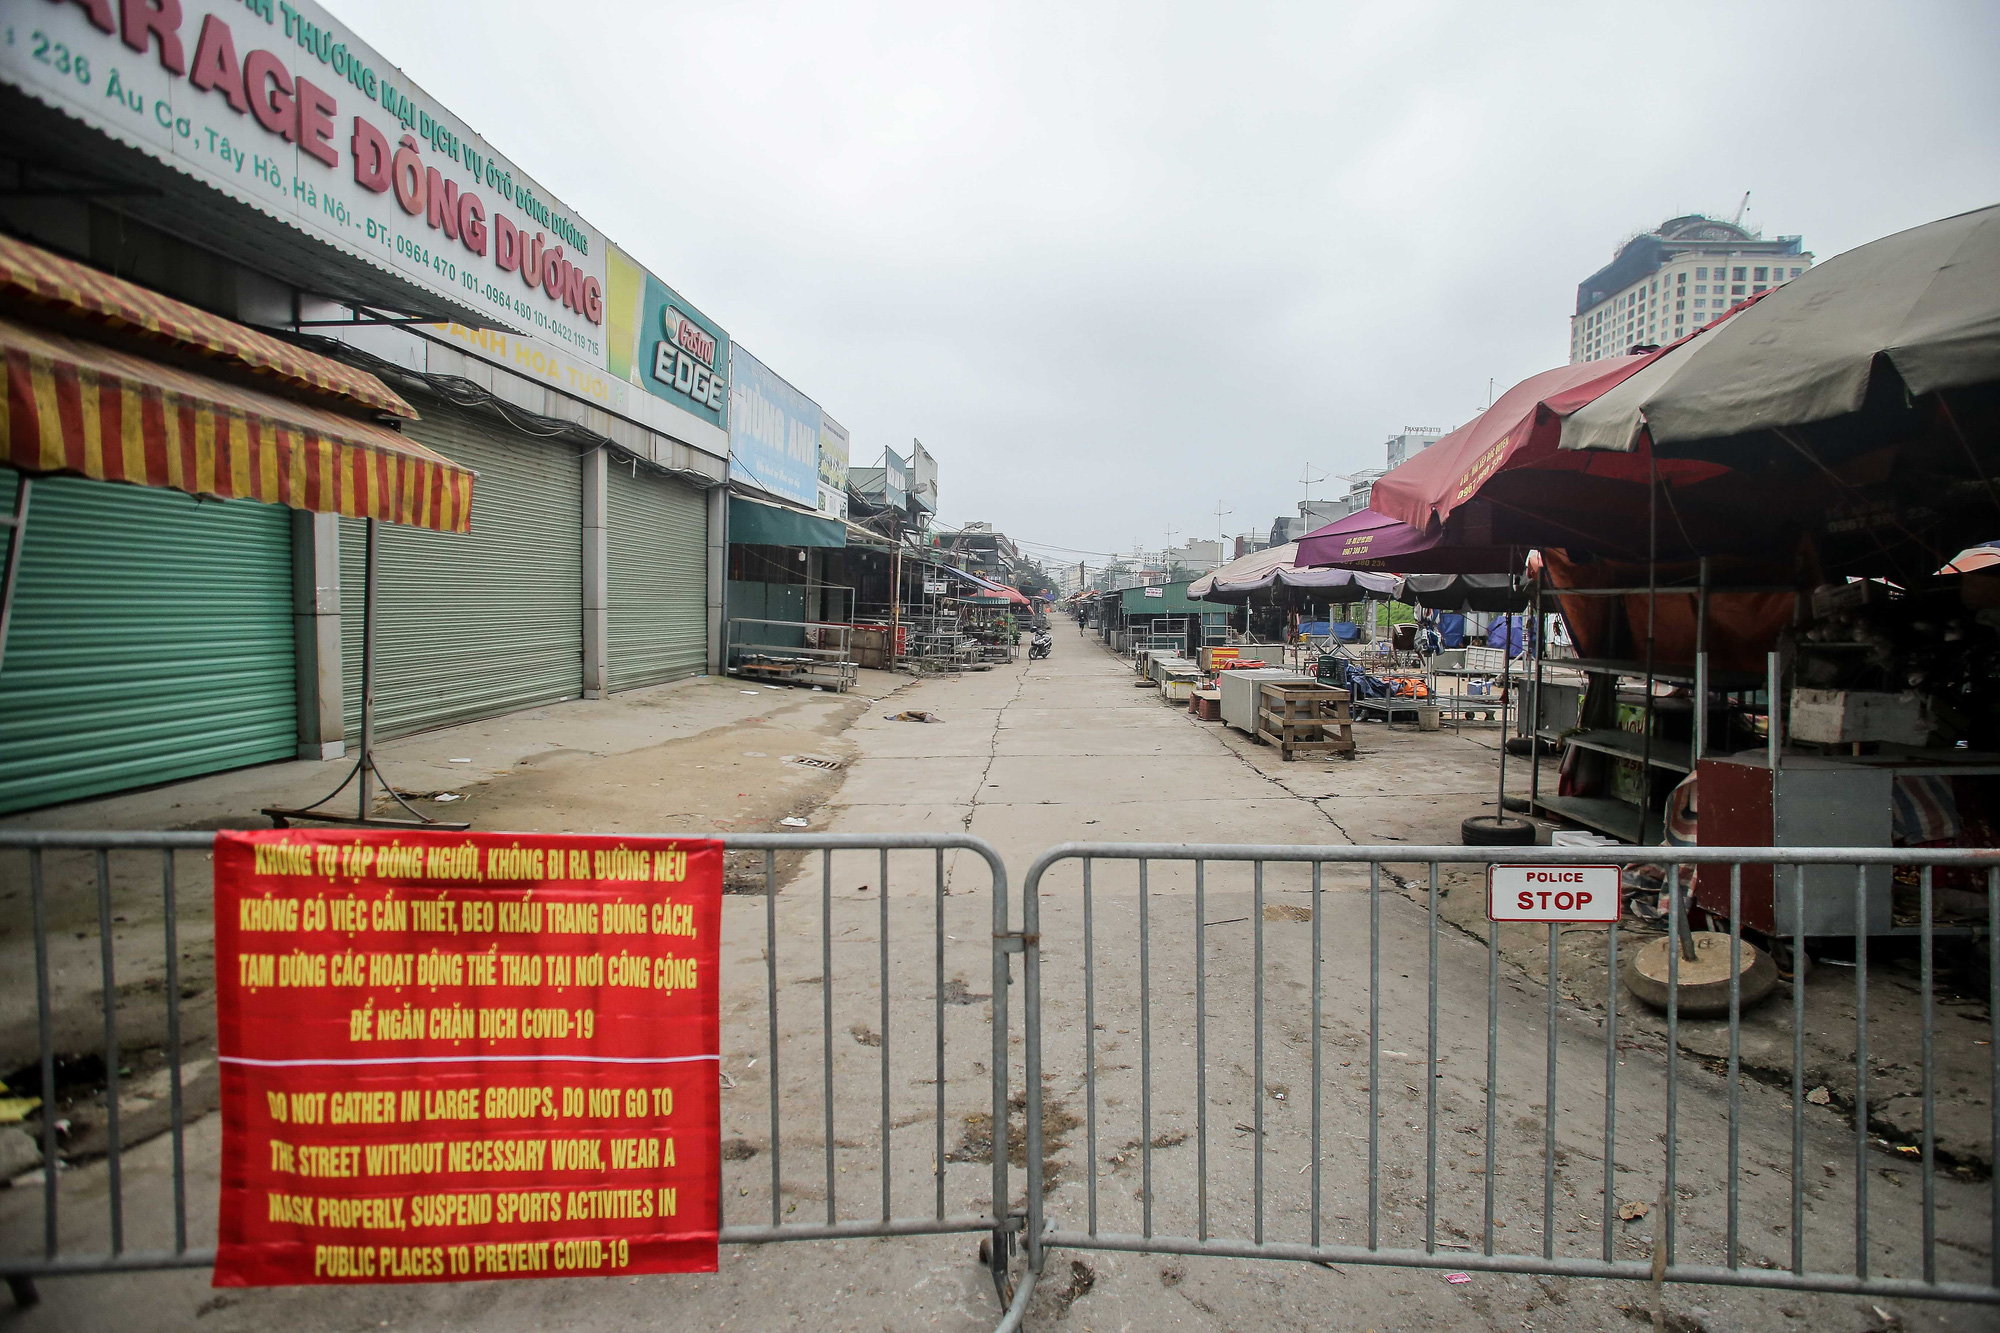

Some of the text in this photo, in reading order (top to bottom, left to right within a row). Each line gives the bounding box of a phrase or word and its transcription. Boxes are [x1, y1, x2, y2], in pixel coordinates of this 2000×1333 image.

[280, 1, 377, 101] THƯƠNG
[381, 80, 416, 130] MẠI
[420, 110, 459, 162] DỊCH
[463, 143, 483, 184] VỤ
[486, 158, 514, 201] ÔTÔ
[515, 185, 550, 229] ĐÔNG
[551, 212, 588, 256] DƯƠNG
[48, 0, 603, 327] RAGE ĐÔNG DƯƠNG
[31, 30, 91, 85] 236
[106, 68, 143, 115] Âu
[204, 126, 244, 173] Tây
[293, 176, 316, 208] Hà
[323, 193, 350, 227] Nội
[396, 235, 429, 268] 0964
[433, 256, 456, 281] 470
[514, 300, 531, 321] 480
[573, 332, 586, 349] 119
[587, 339, 599, 356] 715
[515, 341, 561, 382] HOA
[679, 319, 715, 366] Castrol
[654, 340, 727, 412] EDGE
[254, 836, 313, 877] KHÔNG
[315, 844, 340, 884] TỤ
[341, 837, 375, 884] TẬP
[375, 838, 425, 879] ĐÔNG
[487, 841, 544, 881] KHÔNG
[546, 848, 565, 880] ĐI
[568, 849, 592, 880] RA
[653, 841, 688, 883] NẾU
[1526, 872, 1584, 883] POLICE
[239, 891, 300, 932] KHÔNG
[302, 892, 327, 932] CÓ
[329, 892, 368, 939] VIỆC
[461, 900, 495, 933] ĐEO
[545, 901, 599, 935] TRANG
[601, 896, 648, 935] ĐÚNG
[1517, 891, 1593, 911] STOP
[238, 953, 275, 994] TẠM
[330, 947, 366, 987] CÁC
[369, 953, 414, 994] HOẠT
[416, 947, 464, 993] ĐỘNG
[466, 942, 498, 987] THỂ
[500, 954, 543, 987] THAO
[545, 954, 572, 994] TẠI
[575, 952, 605, 987] NƠI
[607, 948, 652, 989] CÔNG
[653, 951, 698, 997] CỘNG
[349, 996, 595, 1047] ĐỂ NGĂN CHẶN DỊCH COVID-19
[290, 1092, 327, 1125] NOT
[330, 1090, 397, 1125] GATHER
[400, 1089, 421, 1123] IN
[424, 1087, 480, 1121] LARGE
[484, 1085, 559, 1121] GROUPS,
[562, 1086, 585, 1119] DO
[588, 1087, 622, 1119] NOT
[625, 1087, 648, 1119] GO
[651, 1087, 674, 1117] TO
[269, 1137, 676, 1178] THE STREET WITHOUT NECESSARY WORK, WEAR A
[268, 1187, 677, 1232] MASK PROPERLY, SUSPEND SPORTS ACTIVITIES IN
[315, 1238, 629, 1277] PUBLIC PLACES TO PREVENT COVID-19
